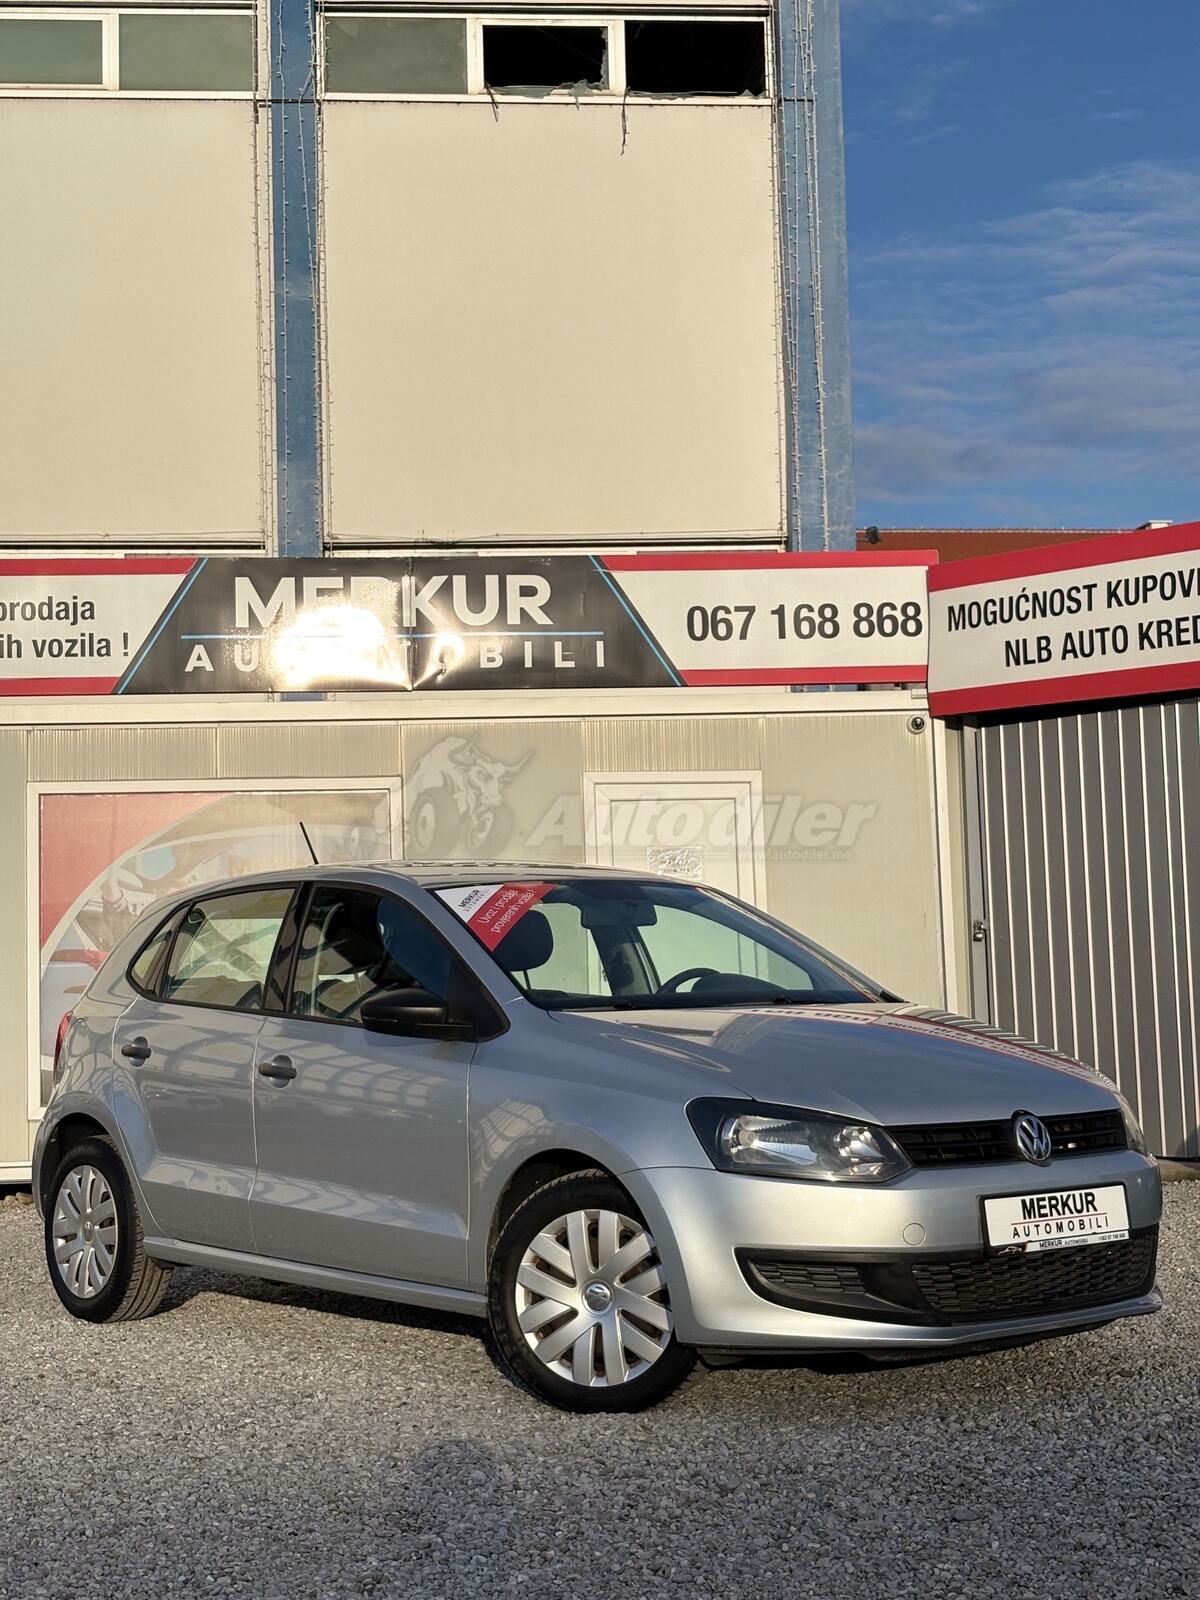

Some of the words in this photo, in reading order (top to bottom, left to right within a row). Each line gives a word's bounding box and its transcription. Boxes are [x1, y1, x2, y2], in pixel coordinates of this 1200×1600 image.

[947, 583, 1098, 632] MOGUĆNOST
[1106, 567, 1200, 609] KUPOV
[686, 604, 754, 641] 067
[770, 603, 840, 640] 168
[853, 601, 923, 638] 868
[32, 632, 112, 658] vozila
[1004, 635, 1052, 667] NLB
[1061, 624, 1129, 661] AUTO
[1020, 1192, 1098, 1220] MERKUR
[1012, 1216, 1109, 1239] AUTOMOBILI
